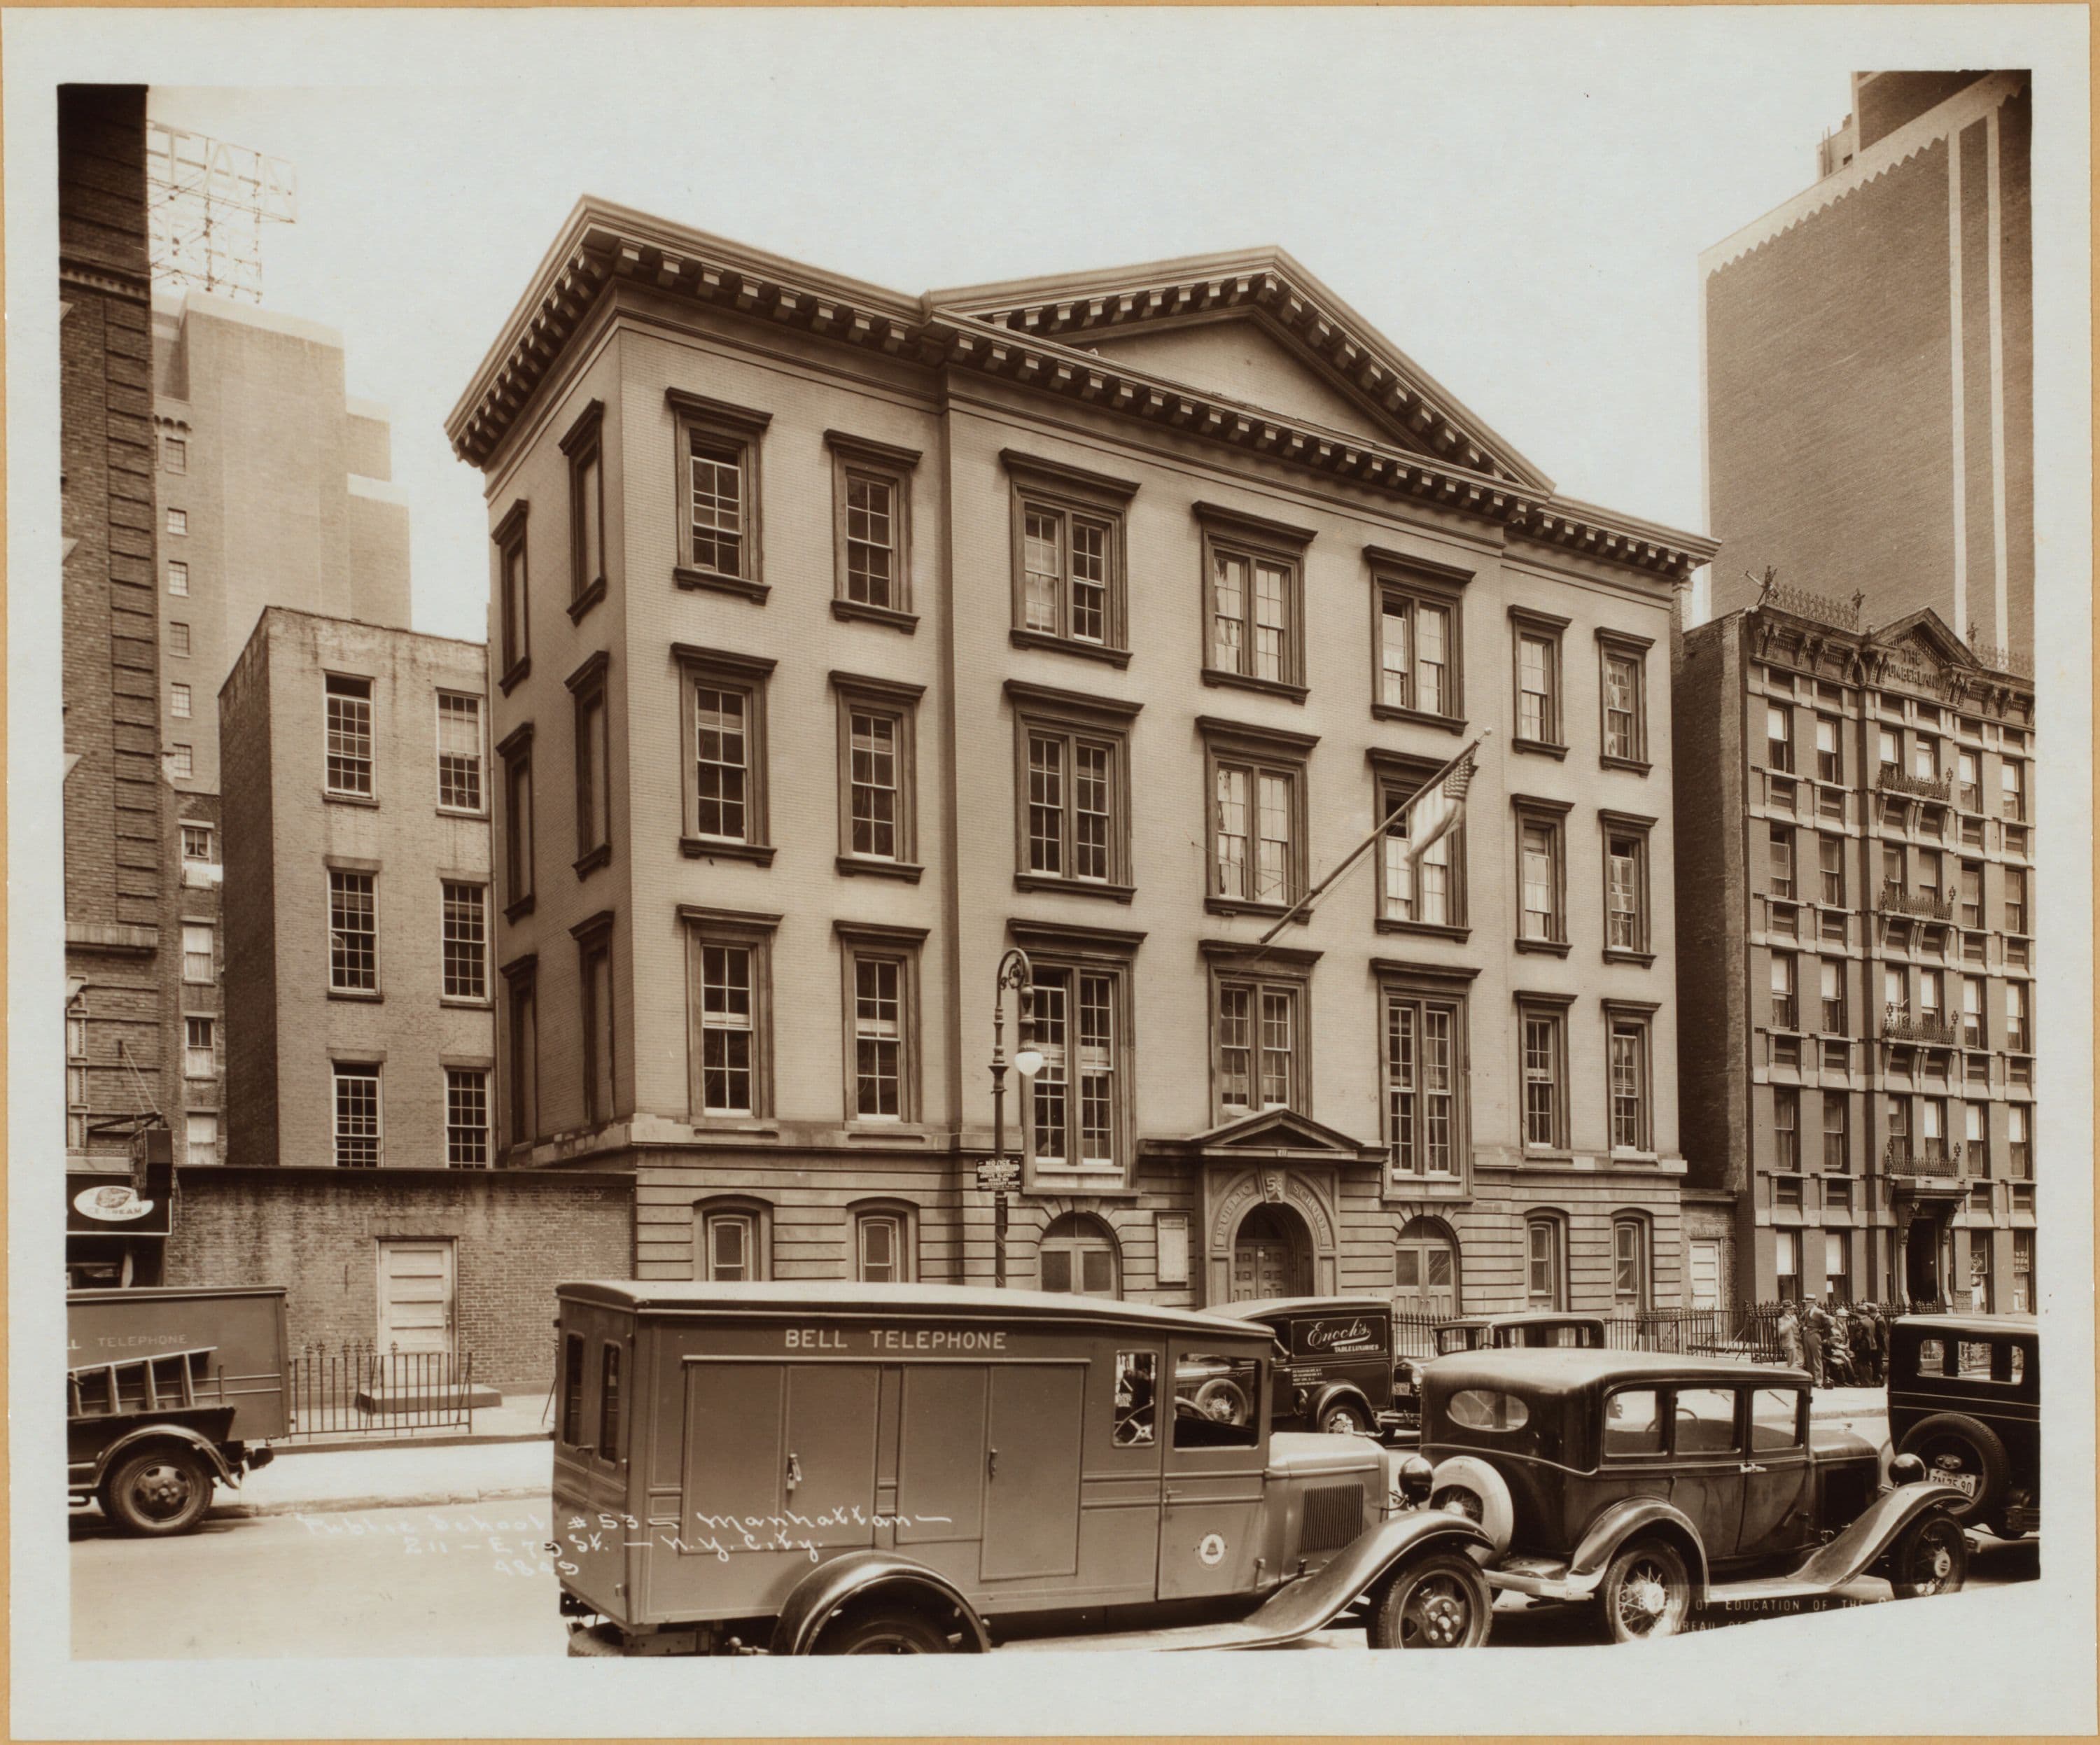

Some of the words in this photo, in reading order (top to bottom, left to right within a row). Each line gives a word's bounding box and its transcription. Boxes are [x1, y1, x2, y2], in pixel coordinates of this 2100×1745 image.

[1902, 648, 1921, 666] THE
[1887, 664, 1941, 689] UMBERLAND
[1217, 1186, 1250, 1237] PUBLIC
[1294, 1184, 1329, 1239] SCHOOL
[97, 1334, 188, 1348] TELEPHONE
[785, 1329, 848, 1348] BELL
[870, 1330, 1007, 1350] TELEPHONE
